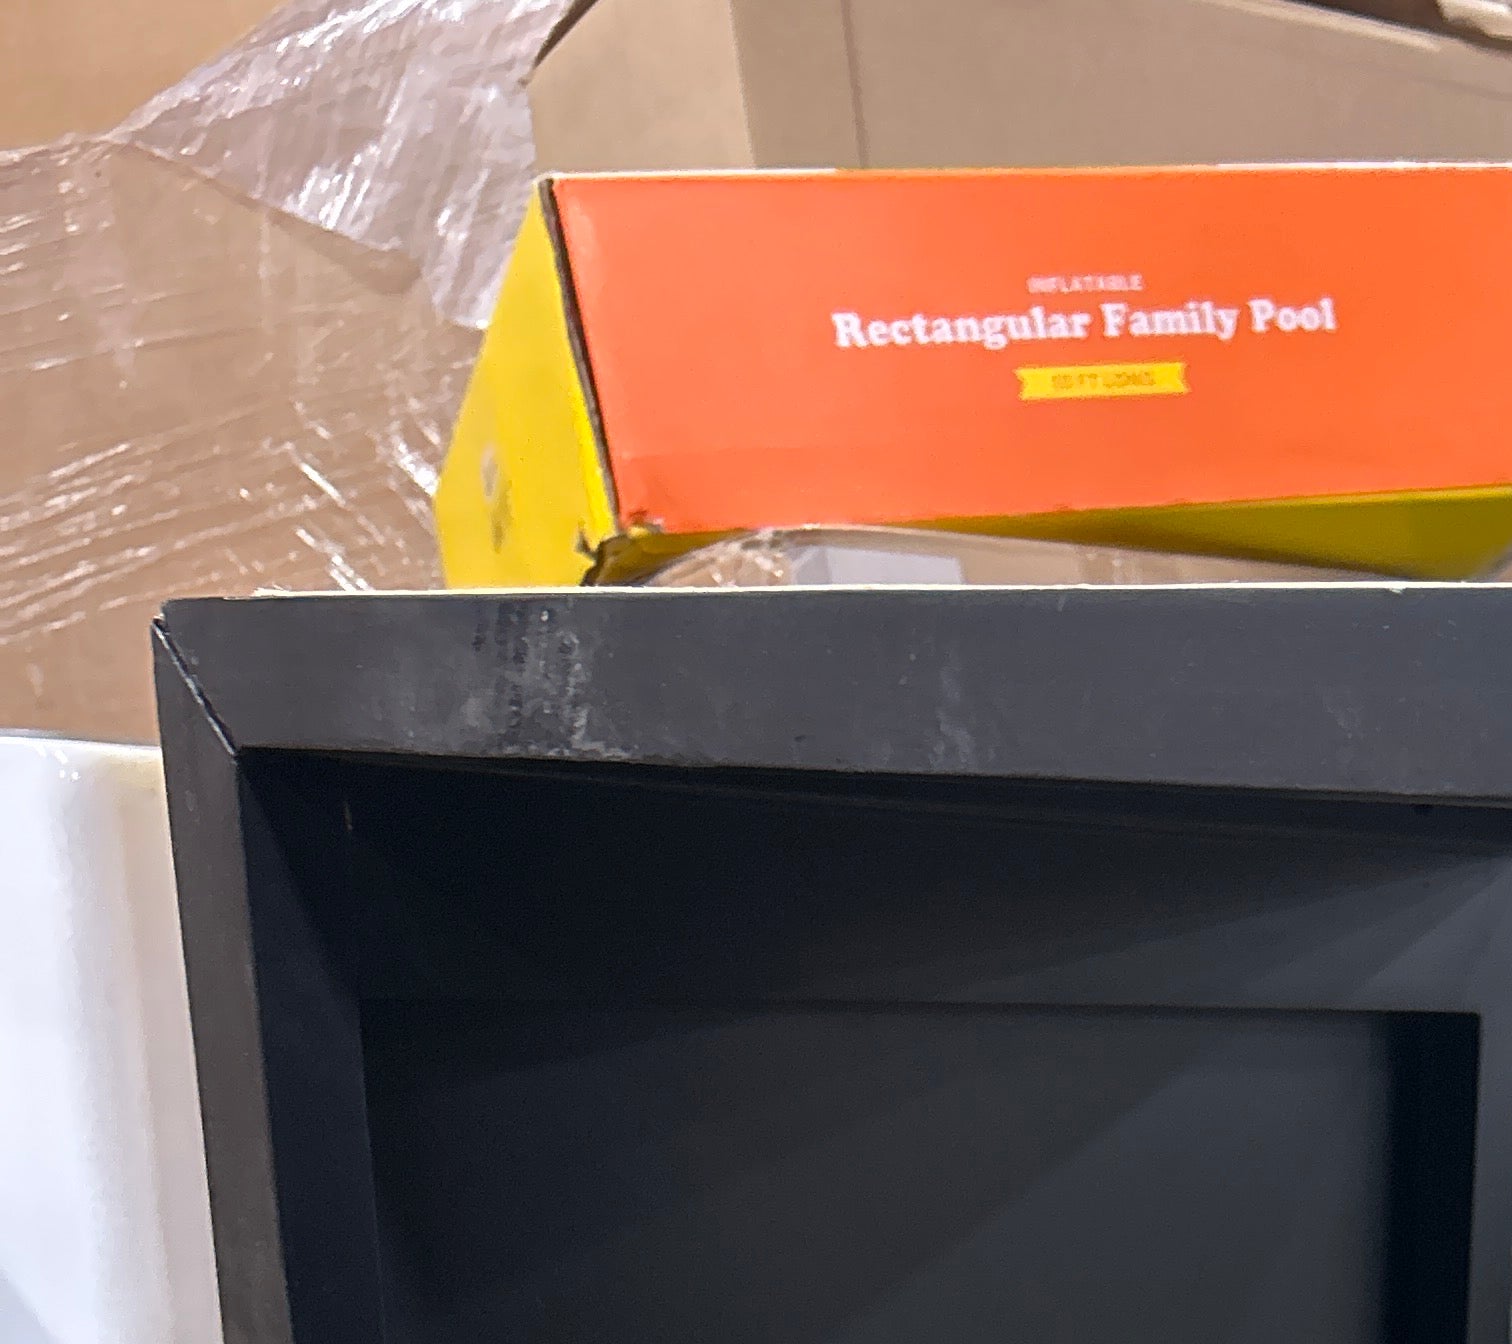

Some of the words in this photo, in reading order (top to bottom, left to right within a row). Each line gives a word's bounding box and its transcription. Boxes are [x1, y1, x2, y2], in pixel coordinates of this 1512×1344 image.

[1026, 274, 1143, 293] INFLATABLE
[831, 305, 1091, 350] Rectangular
[1100, 300, 1240, 340] Family
[1249, 298, 1337, 333] Pool
